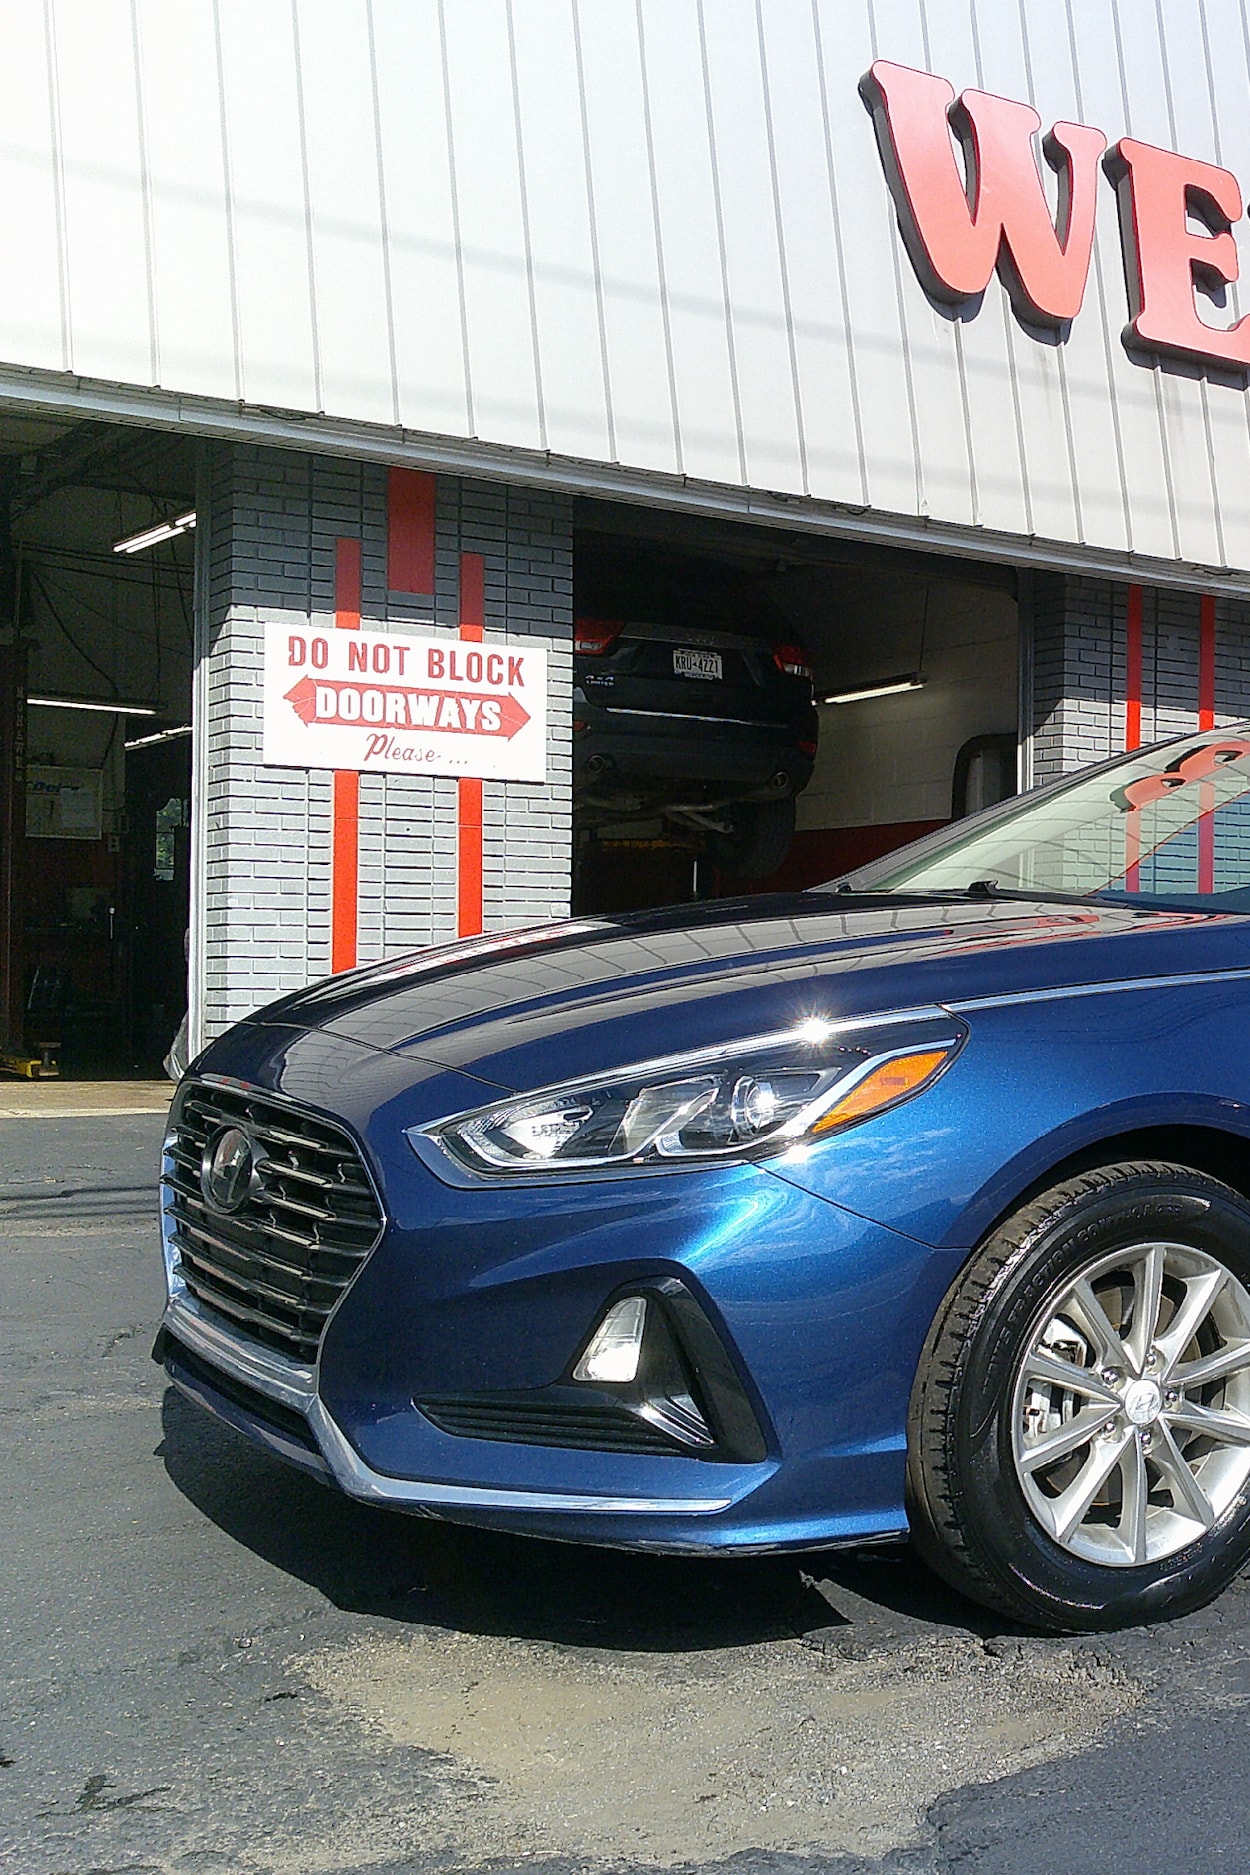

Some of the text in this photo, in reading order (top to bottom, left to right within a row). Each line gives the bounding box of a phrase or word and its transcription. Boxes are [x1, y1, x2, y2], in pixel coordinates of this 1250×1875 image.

[288, 635, 525, 687] DO NOT BLOCK
[315, 685, 503, 731] DOORWAYS
